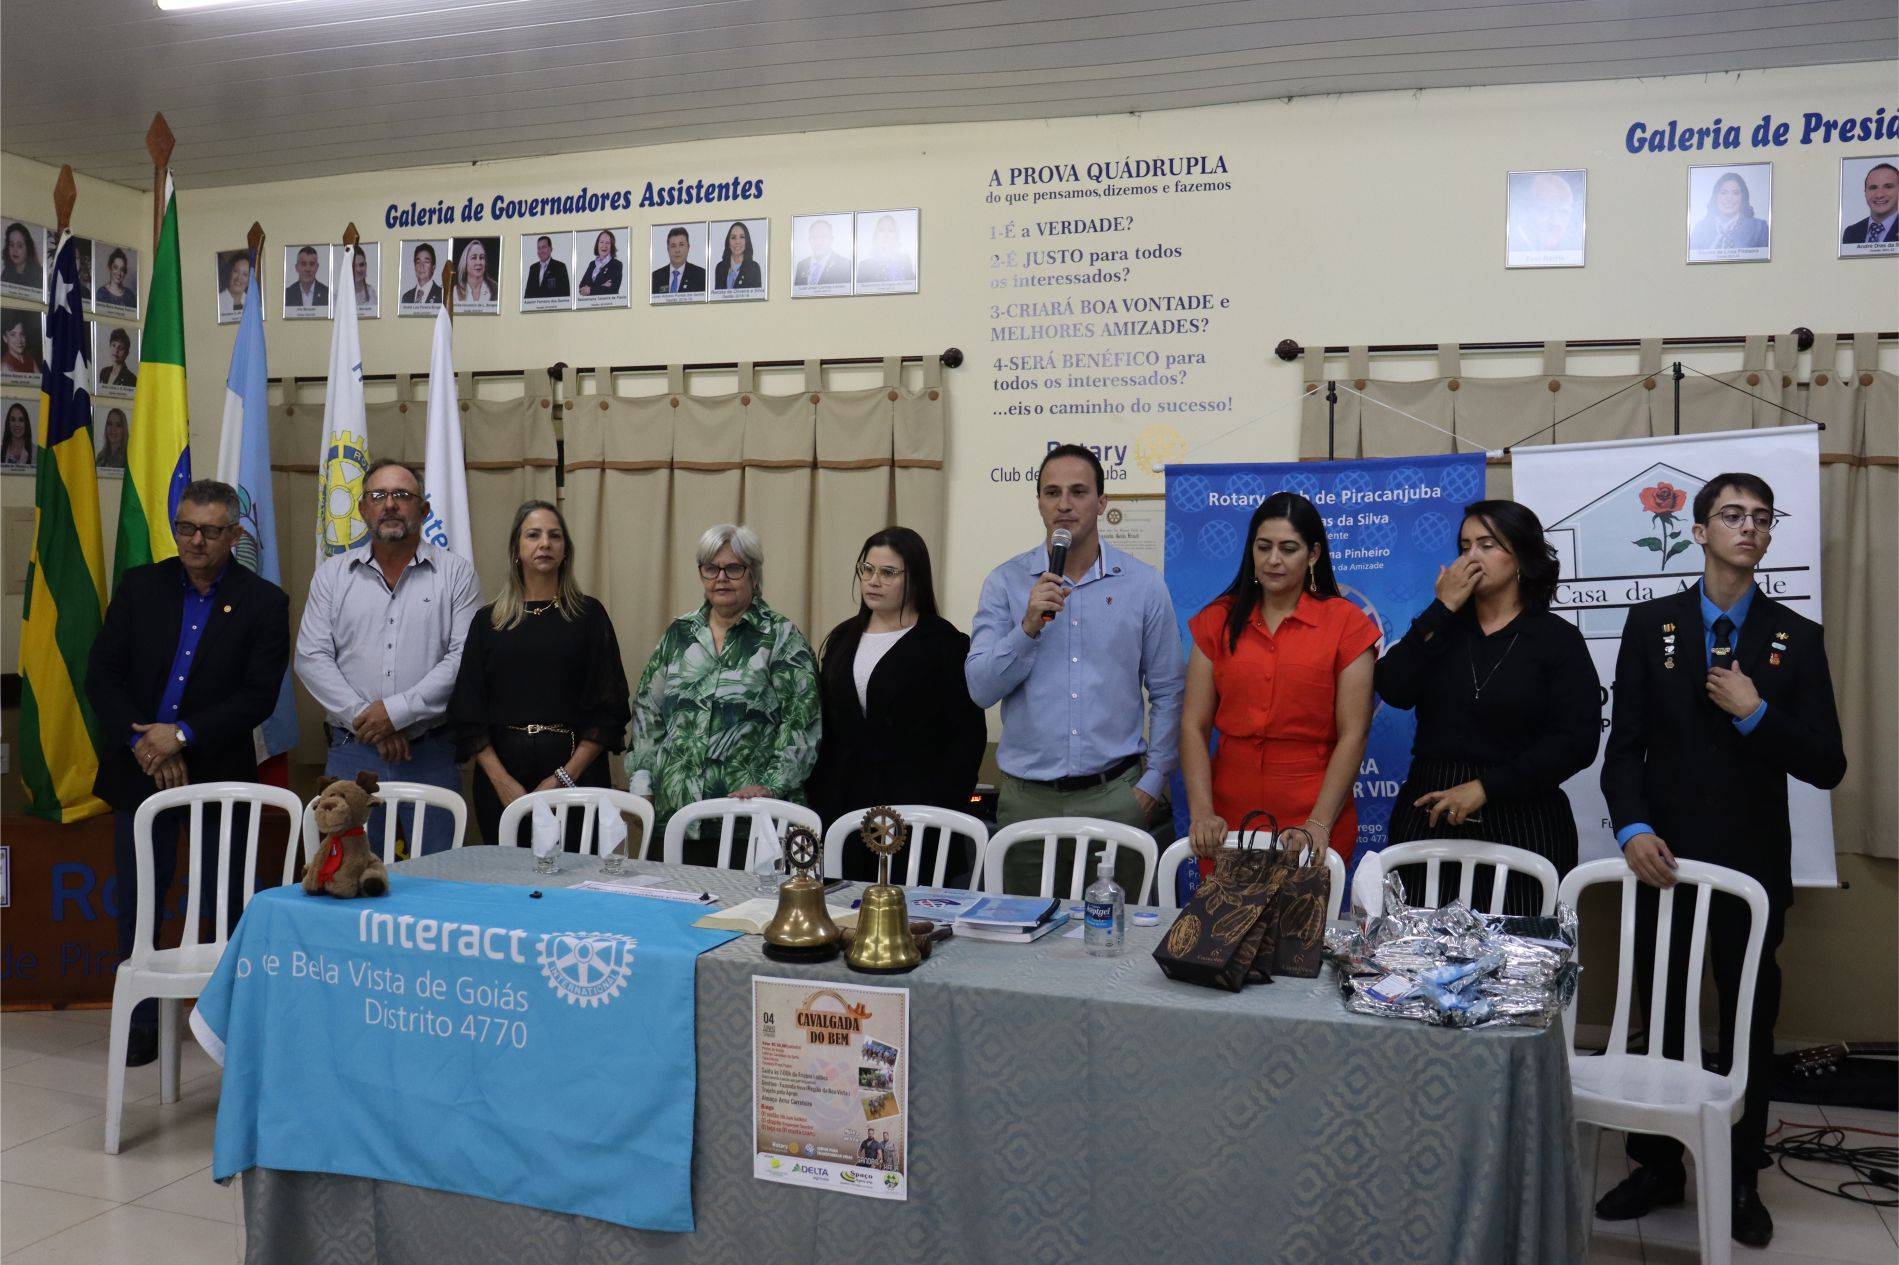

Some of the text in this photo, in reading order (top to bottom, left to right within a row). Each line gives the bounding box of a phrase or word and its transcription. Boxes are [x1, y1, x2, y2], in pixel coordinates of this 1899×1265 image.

[1625, 118, 1741, 154] Galeria
[1751, 115, 1790, 147] de
[988, 155, 1228, 187] A PROVA QUÁDRUPLA
[385, 177, 764, 229] Galeria de Governadores Assistentes
[986, 191, 1001, 203] do
[1005, 190, 1029, 205] que
[1103, 184, 1158, 197] dizemos
[1163, 183, 1170, 193] e
[1175, 179, 1231, 193] fazemos
[1021, 227, 1031, 238] a
[1036, 216, 1134, 236] VERDADE?
[1023, 249, 1084, 268] JUSTO
[1089, 248, 1128, 266] para
[1135, 244, 1182, 260] todos
[990, 267, 1130, 289] os interessados?
[990, 294, 1230, 319] 3-CRIARÁ BOA VONTADE e
[990, 318, 1210, 342] MELHORES AMIZADES?
[993, 349, 1207, 371] 4-SERÁ BENÉFICO para
[993, 370, 1187, 391] todos os interessados?
[1034, 404, 1043, 415] o
[1049, 399, 1125, 415] caminho
[1130, 398, 1152, 413] do
[1157, 397, 1232, 413] sucesso!
[991, 467, 1040, 482] Club de
[1208, 492, 1266, 509] Rotary
[1315, 492, 1336, 505] de
[1341, 484, 1442, 504] Piracanjuba
[1337, 514, 1353, 526] da
[1357, 513, 1389, 525] Silva
[1345, 548, 1390, 559] Pinheiro
[1350, 562, 1384, 571] Amizade
[1554, 585, 1607, 605] Casa
[1626, 581, 1654, 601] da
[1367, 780, 1406, 797] VID
[1371, 835, 1388, 843] 477
[359, 909, 527, 963] Interact
[292, 951, 338, 985] Bela
[349, 960, 405, 995] Vista
[415, 970, 447, 1000] de
[457, 976, 529, 1012] Goiás
[365, 998, 527, 1048] Distrito 4770
[763, 1012, 775, 1025] 04
[797, 1012, 860, 1031] CAVALGADA
[810, 1031, 849, 1045] DO BEM
[802, 1165, 829, 1177] DELTA
